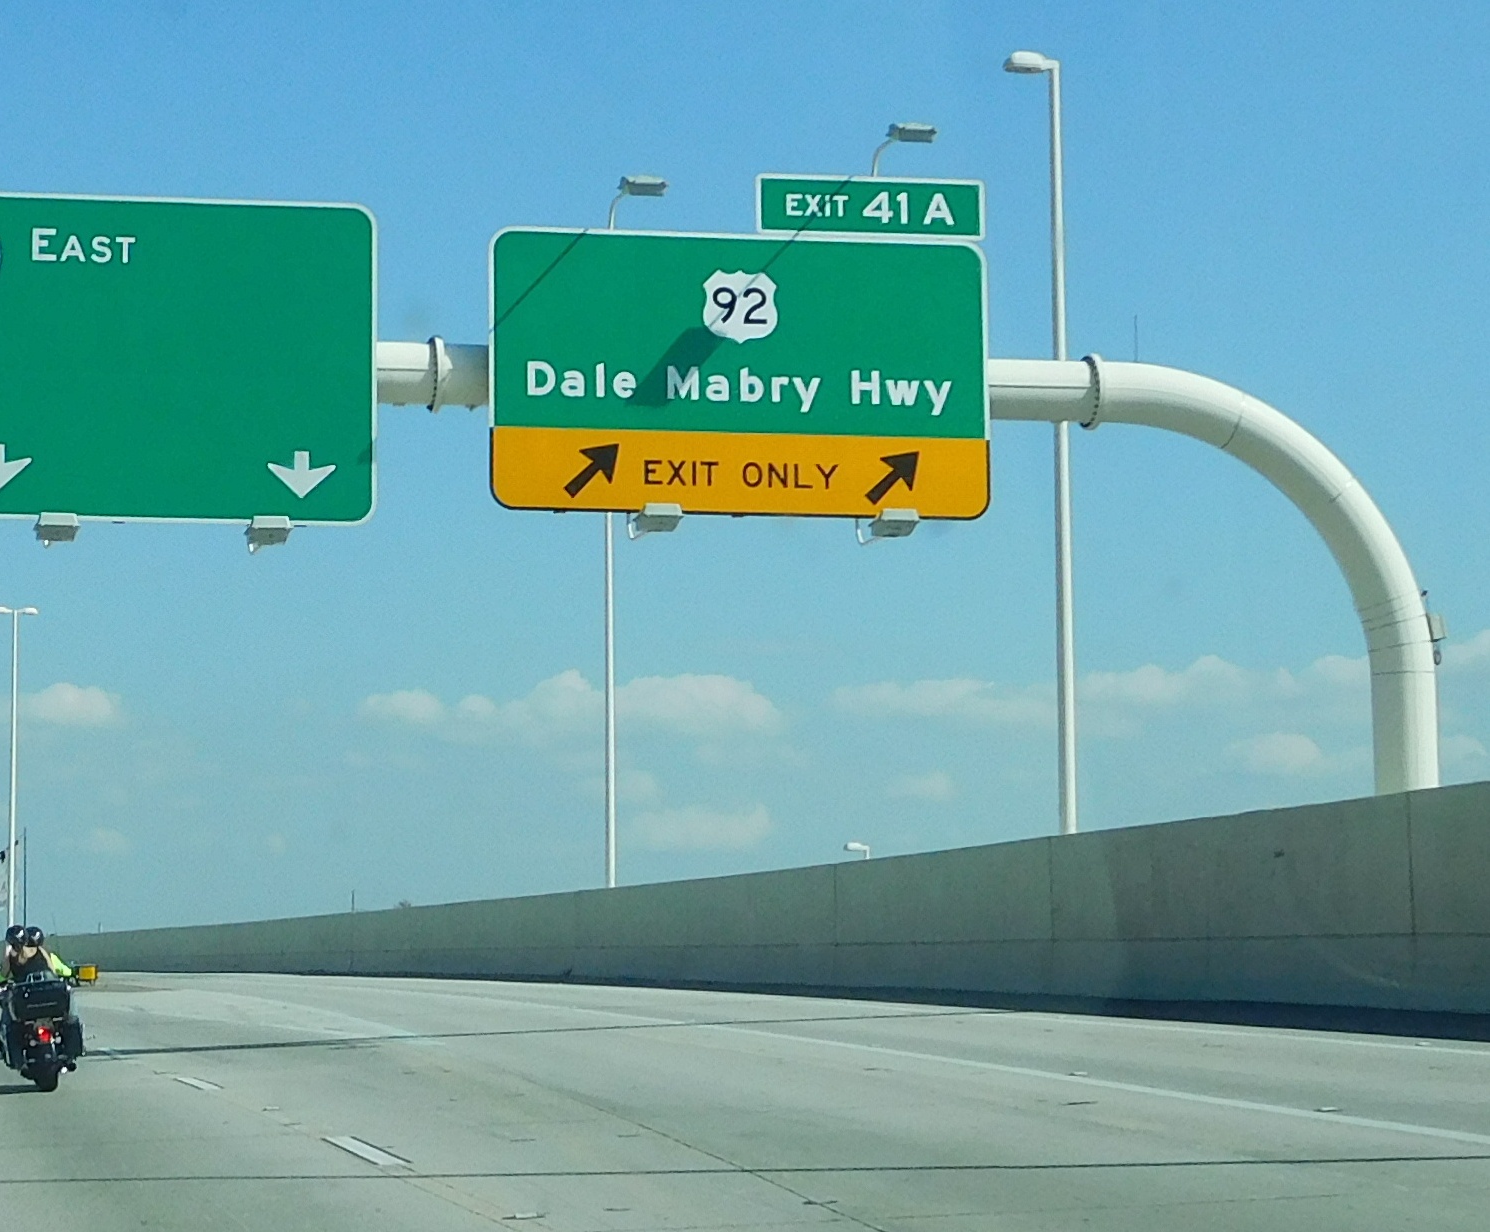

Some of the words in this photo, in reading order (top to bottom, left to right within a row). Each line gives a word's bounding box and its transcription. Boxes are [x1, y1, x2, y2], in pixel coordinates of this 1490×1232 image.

[785, 193, 849, 218] EXIT
[862, 191, 909, 225] 41
[923, 193, 955, 226] A
[31, 227, 136, 264] EAST
[712, 286, 768, 325] 92
[526, 360, 637, 399] Dale
[667, 365, 821, 413] Mabry
[851, 369, 952, 416] Hwy
[643, 459, 719, 487] EXIT
[742, 461, 839, 490] ONLY
